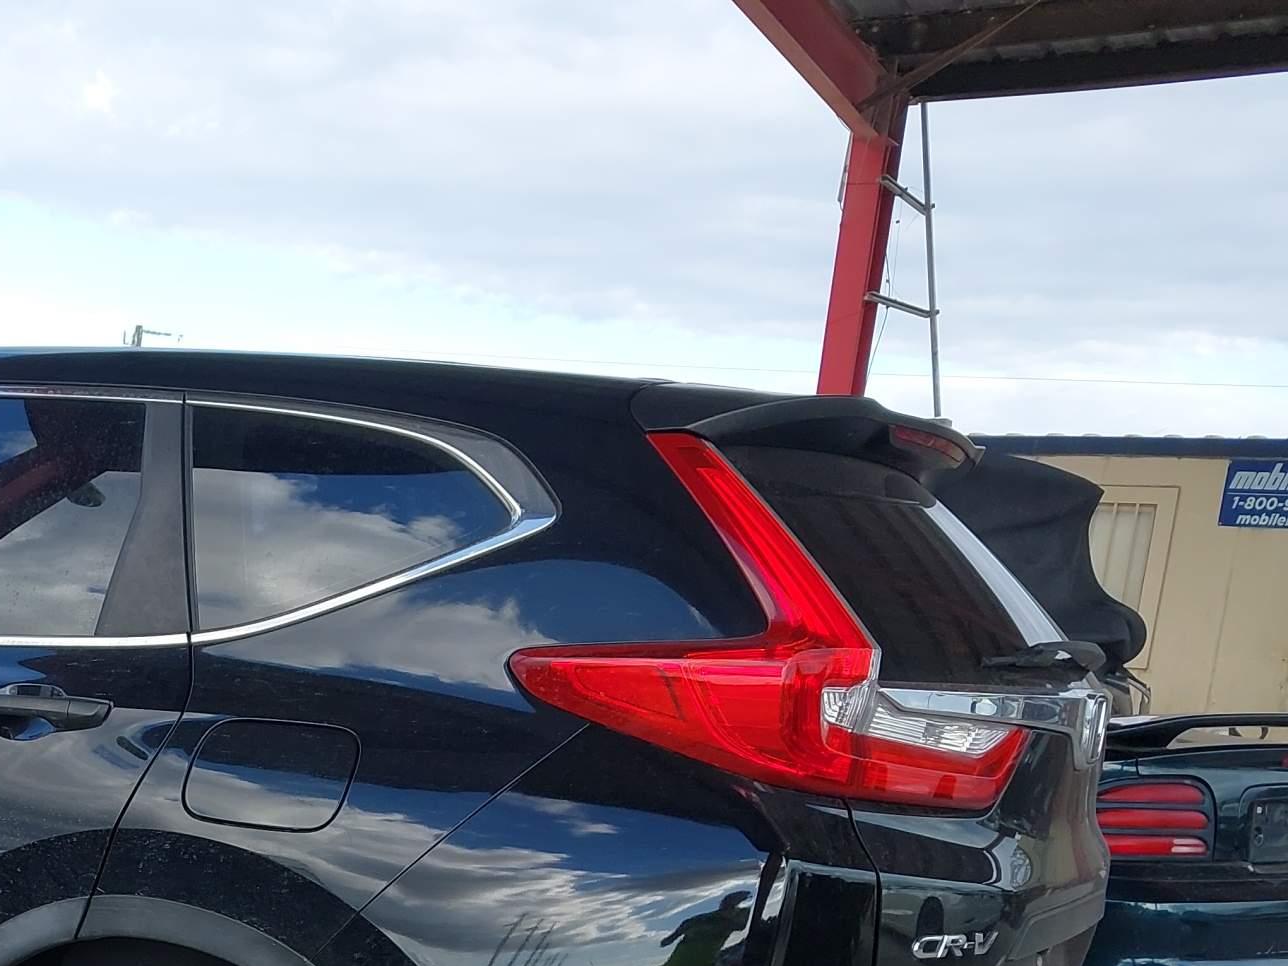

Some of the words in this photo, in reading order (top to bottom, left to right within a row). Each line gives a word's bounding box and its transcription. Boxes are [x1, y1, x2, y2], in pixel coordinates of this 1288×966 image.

[1229, 463, 1288, 490] mobi
[1235, 512, 1288, 526] mobile
[912, 931, 999, 959] CR-V
